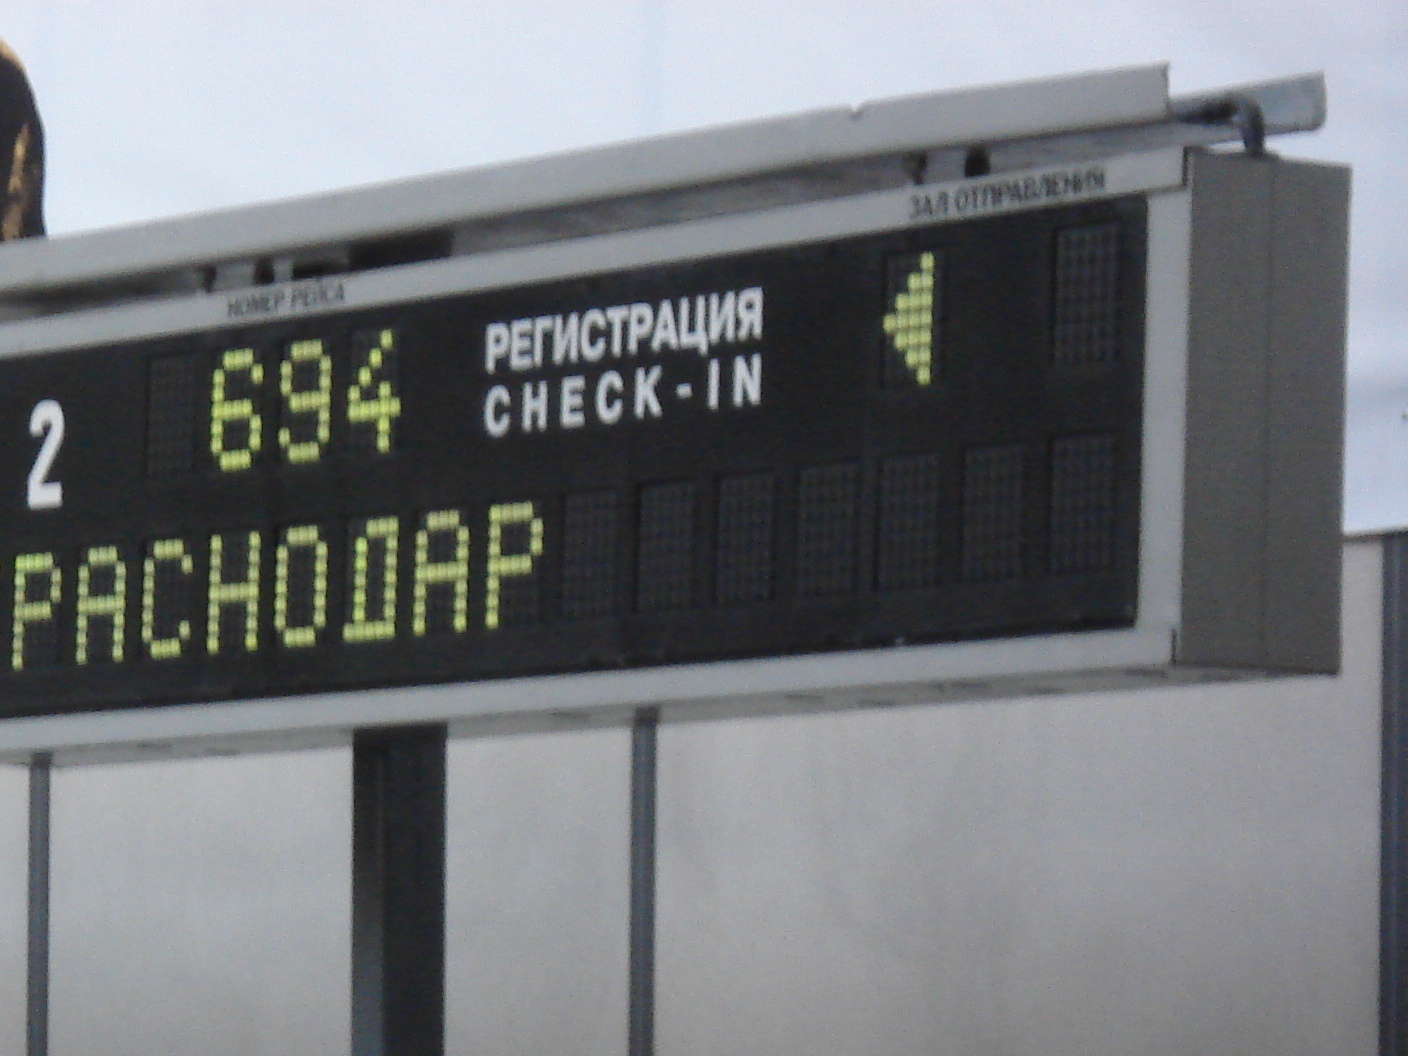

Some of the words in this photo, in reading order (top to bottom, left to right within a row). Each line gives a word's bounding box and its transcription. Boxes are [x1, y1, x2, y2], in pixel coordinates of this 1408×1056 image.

[484, 286, 764, 375] РЕГИСТРАЦИЯ
[27, 400, 66, 510] 2
[210, 329, 401, 472] 694
